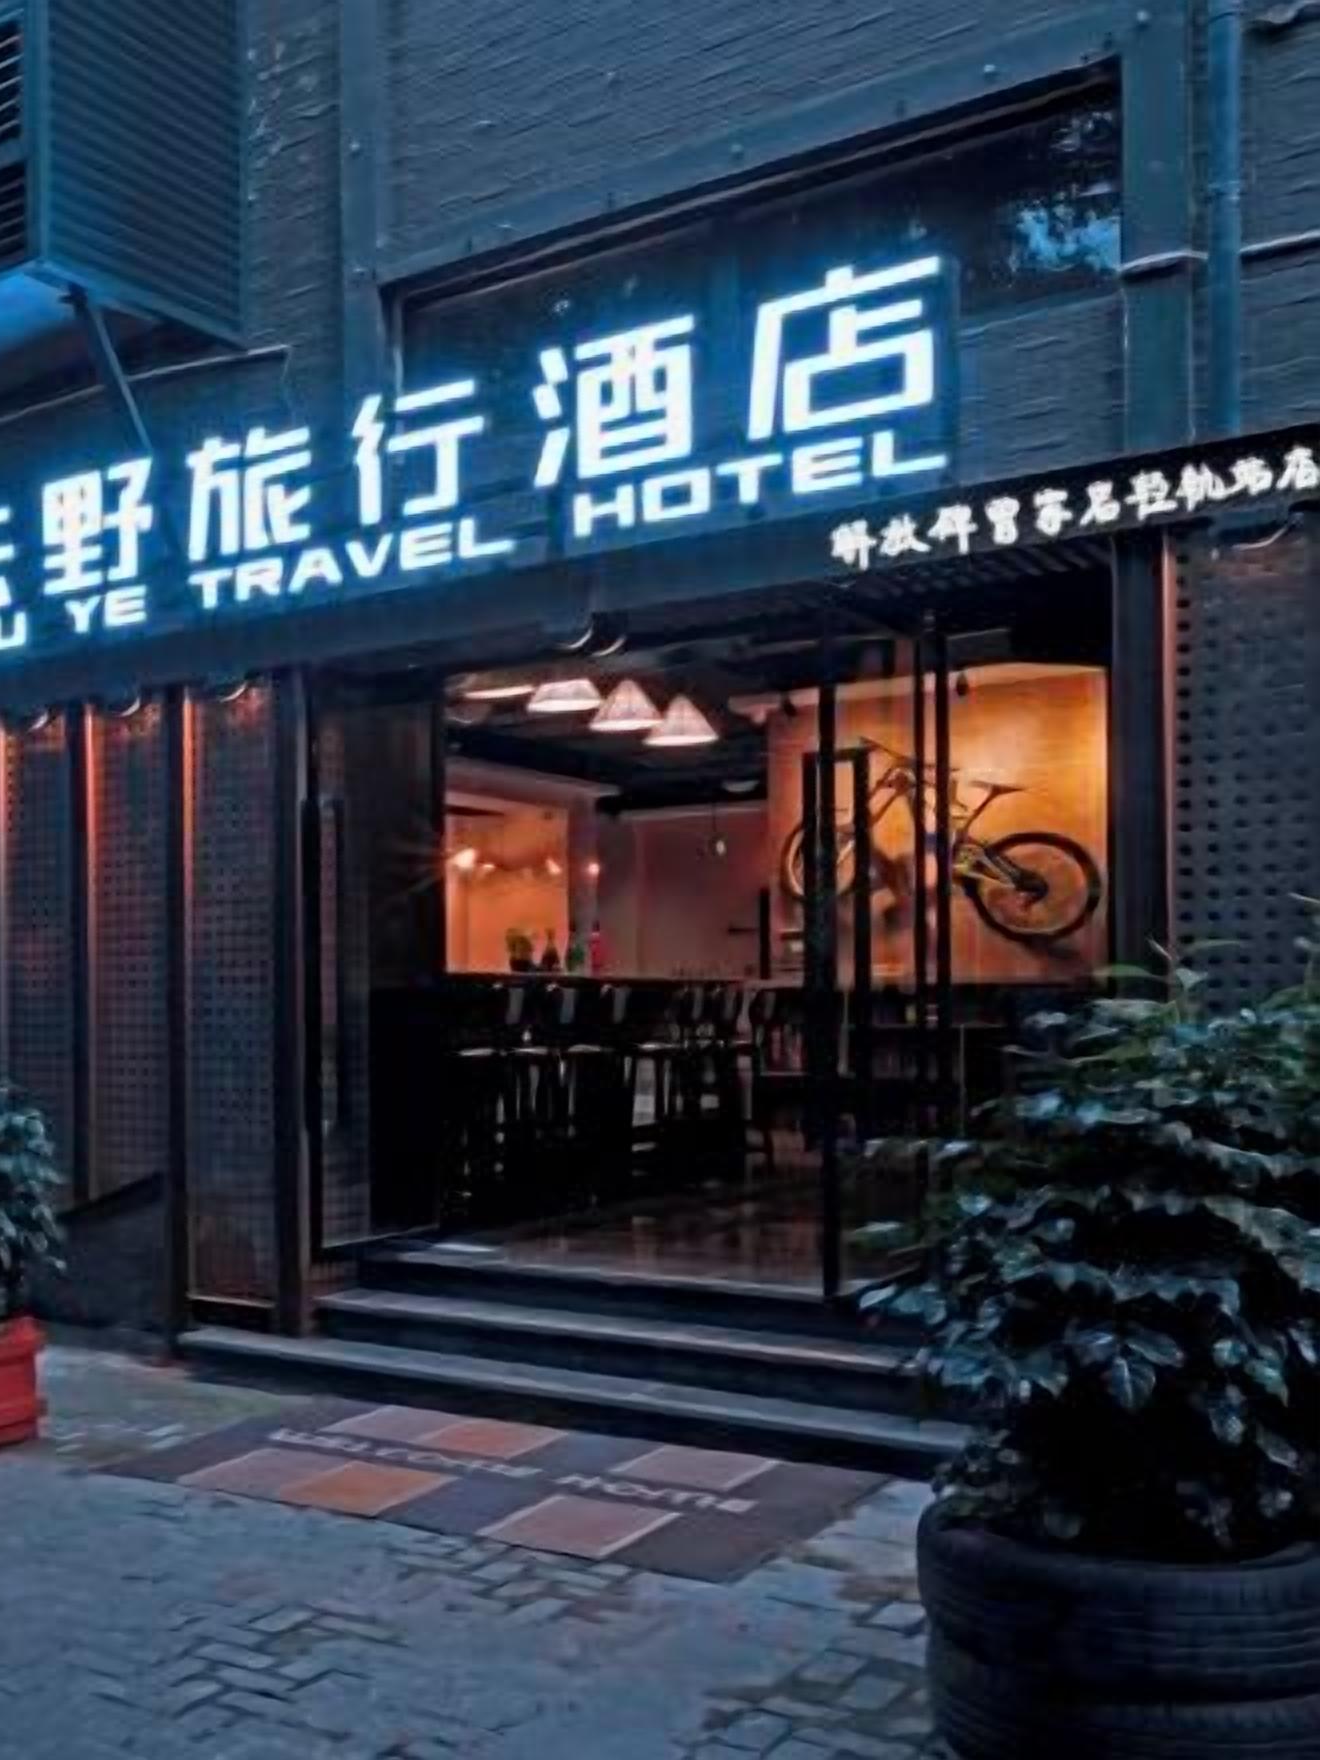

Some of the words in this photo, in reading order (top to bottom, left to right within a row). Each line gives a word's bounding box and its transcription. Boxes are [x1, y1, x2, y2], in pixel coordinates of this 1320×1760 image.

[65, 585, 147, 633] YE
[188, 517, 513, 609] TRAVEL
[573, 430, 948, 537] HOTEL
